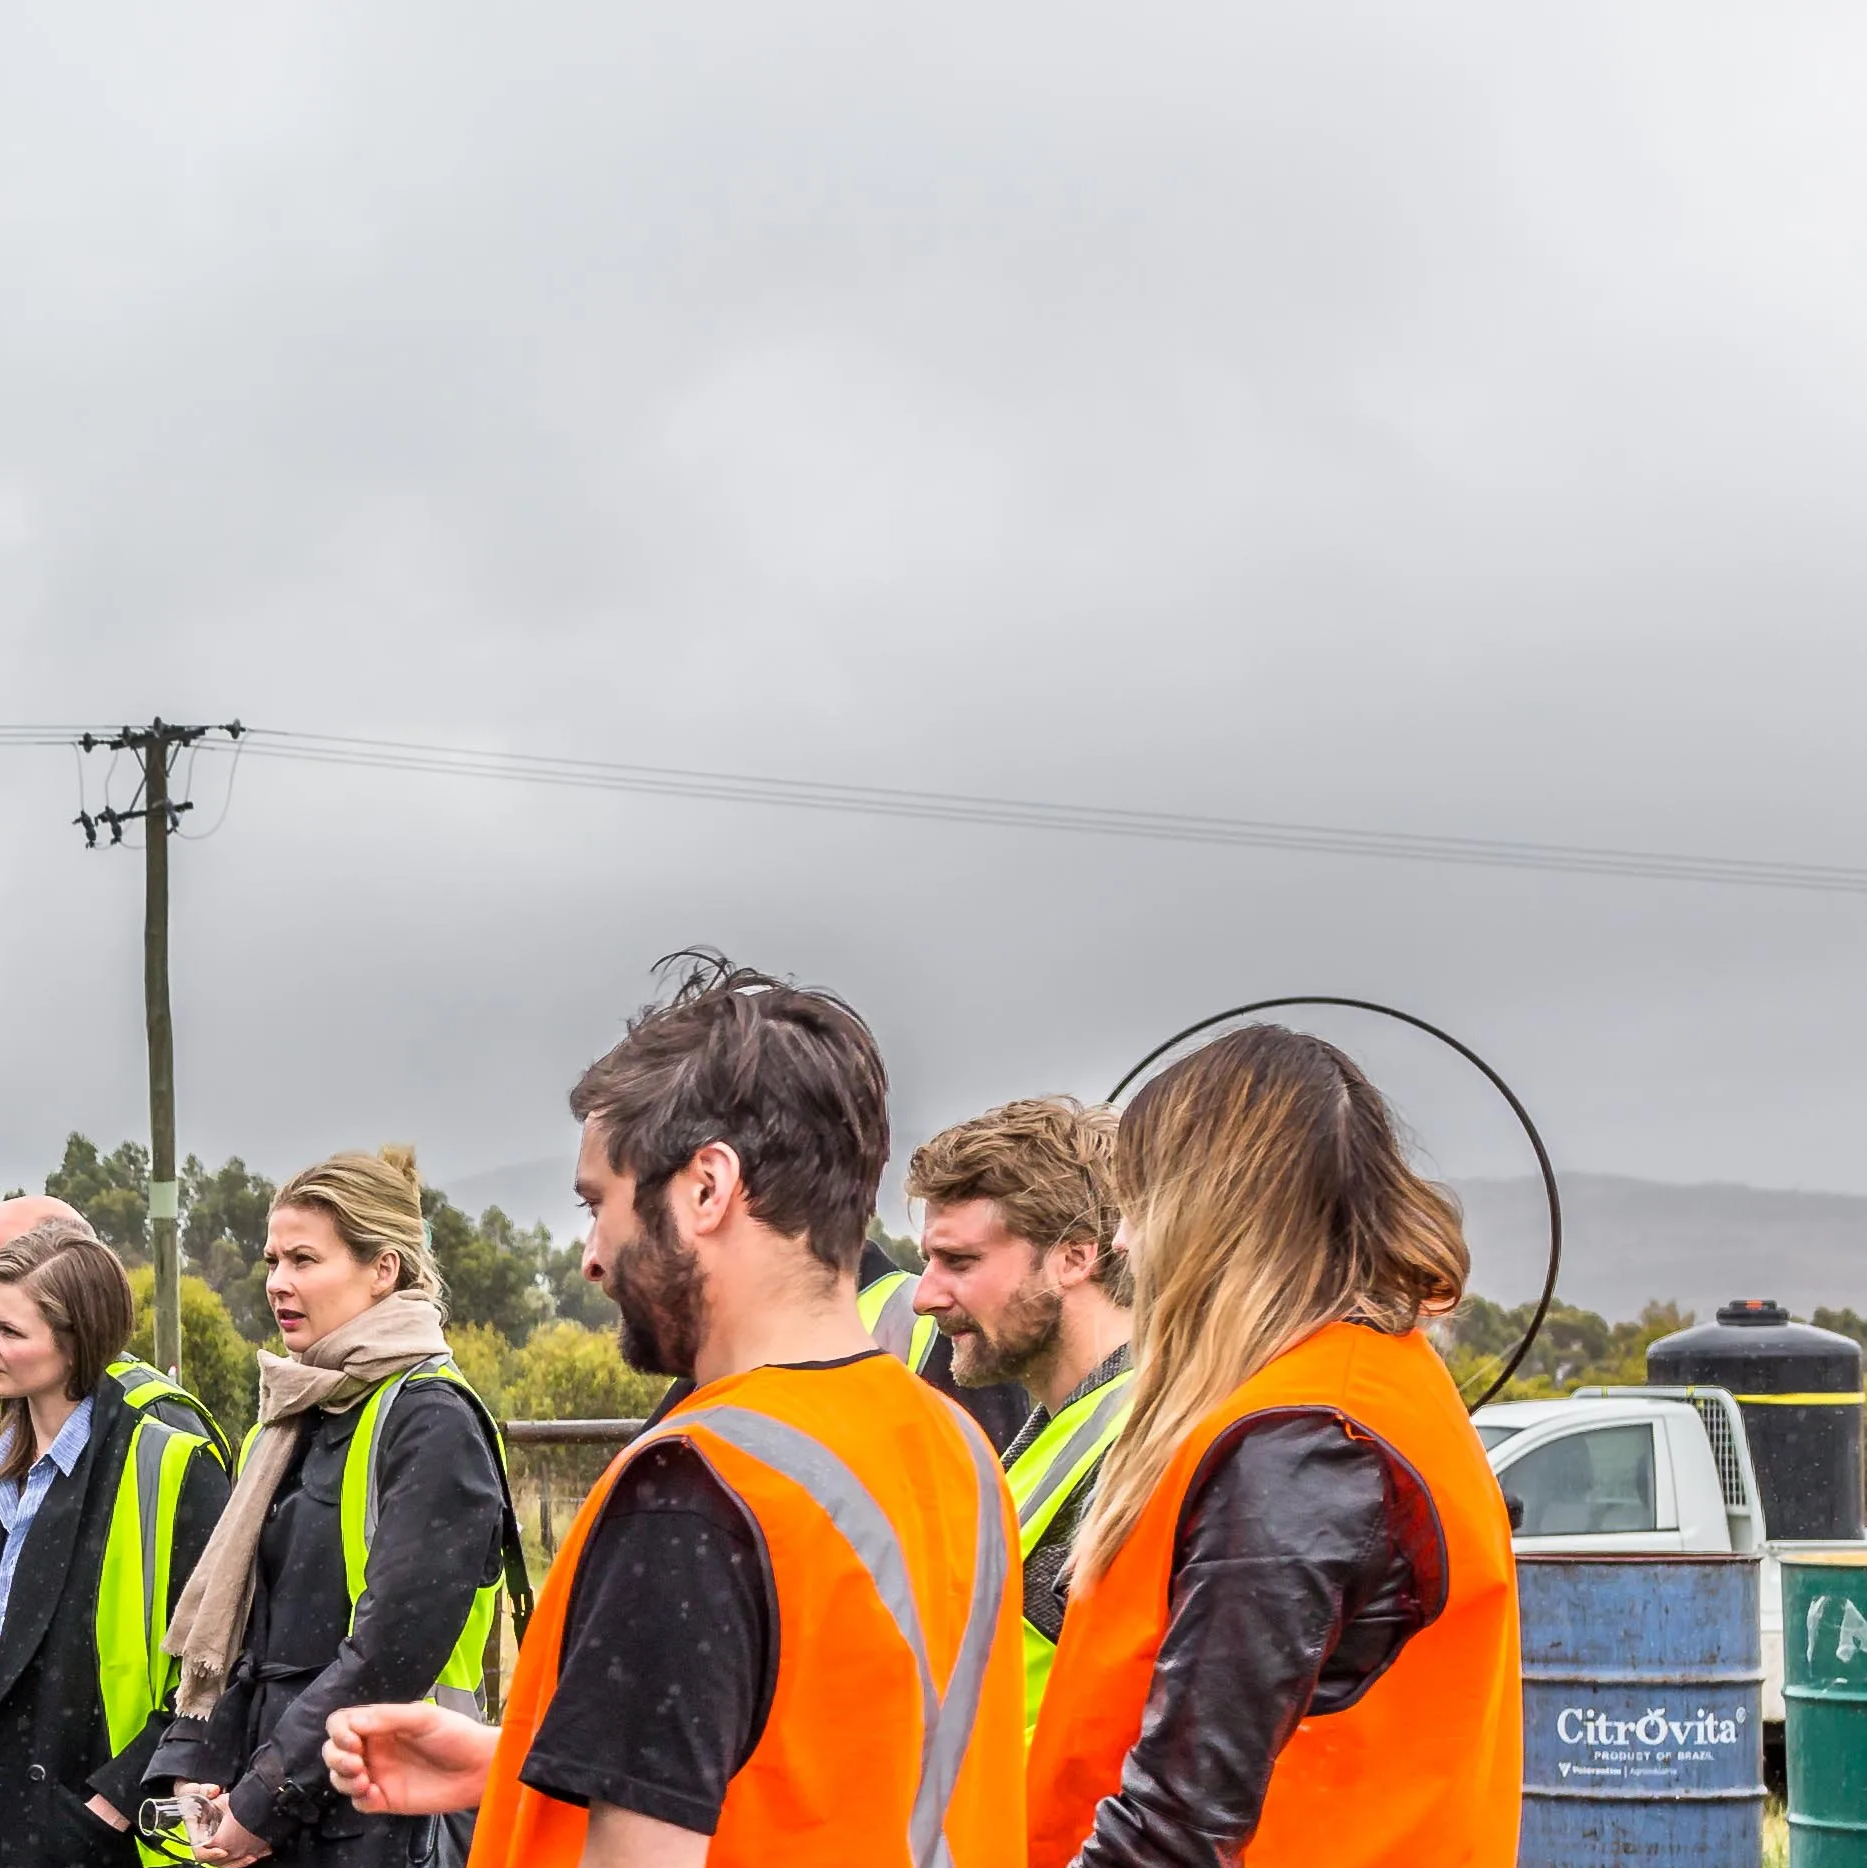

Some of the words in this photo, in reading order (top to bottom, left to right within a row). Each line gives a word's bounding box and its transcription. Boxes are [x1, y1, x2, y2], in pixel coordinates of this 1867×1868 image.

[1594, 1751, 1650, 1761] PRODUCT
[1656, 1751, 1672, 1761] OF
[1677, 1751, 1714, 1761] BRAZIL
